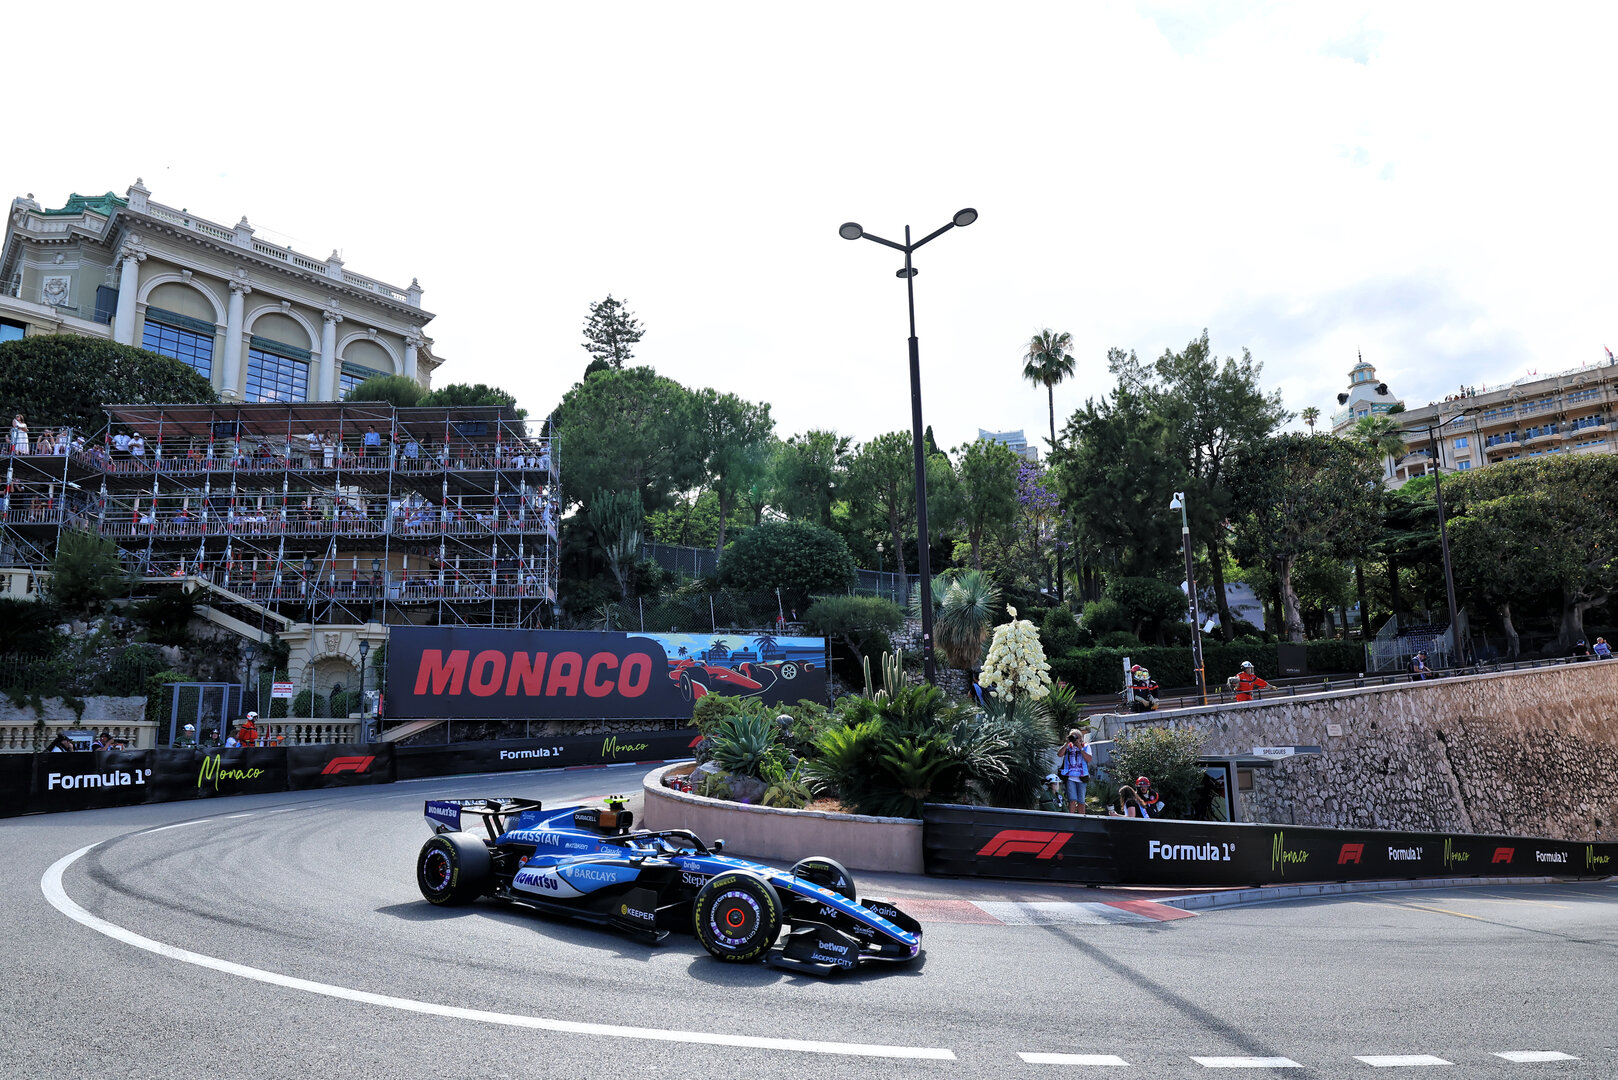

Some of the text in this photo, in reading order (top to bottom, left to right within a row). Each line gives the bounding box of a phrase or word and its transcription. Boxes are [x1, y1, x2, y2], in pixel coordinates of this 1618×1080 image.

[413, 649, 653, 698] MONACO
[500, 747, 550, 760] Formula
[602, 735, 648, 759] Monaco
[48, 770, 131, 790] Formula
[197, 754, 264, 791] Monaco
[428, 805, 457, 818] KOMATSU
[574, 813, 597, 822] DURACELL
[506, 830, 560, 847] ATLASSIAN
[600, 845, 622, 855] Claude
[1149, 840, 1220, 861] Formula
[1272, 831, 1309, 876] Monaco
[1388, 846, 1416, 861] Formula
[1443, 837, 1470, 871] Monaco
[1535, 850, 1562, 863] Formula
[1585, 844, 1611, 872] Monaco
[514, 871, 559, 890] KOMATSU
[574, 868, 617, 882] BARCLAYS
[627, 907, 655, 921] KEEPER
[878, 905, 897, 918] airia
[819, 940, 848, 954] betway
